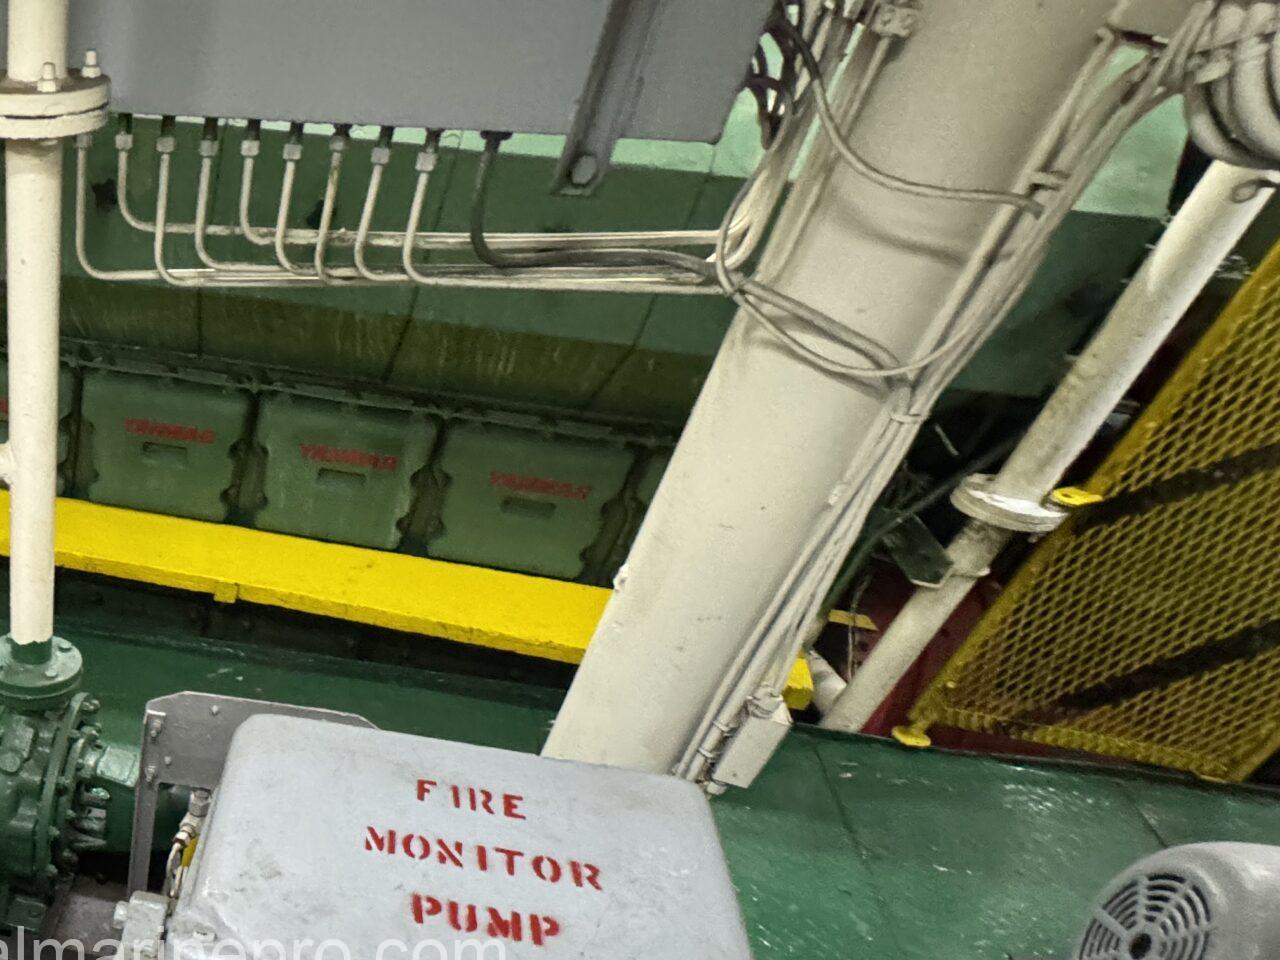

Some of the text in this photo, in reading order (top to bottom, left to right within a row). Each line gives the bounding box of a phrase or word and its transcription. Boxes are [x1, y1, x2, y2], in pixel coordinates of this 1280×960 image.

[417, 778, 526, 820] FIRE
[364, 825, 602, 891] MONITOR
[410, 892, 561, 946] PUMP
